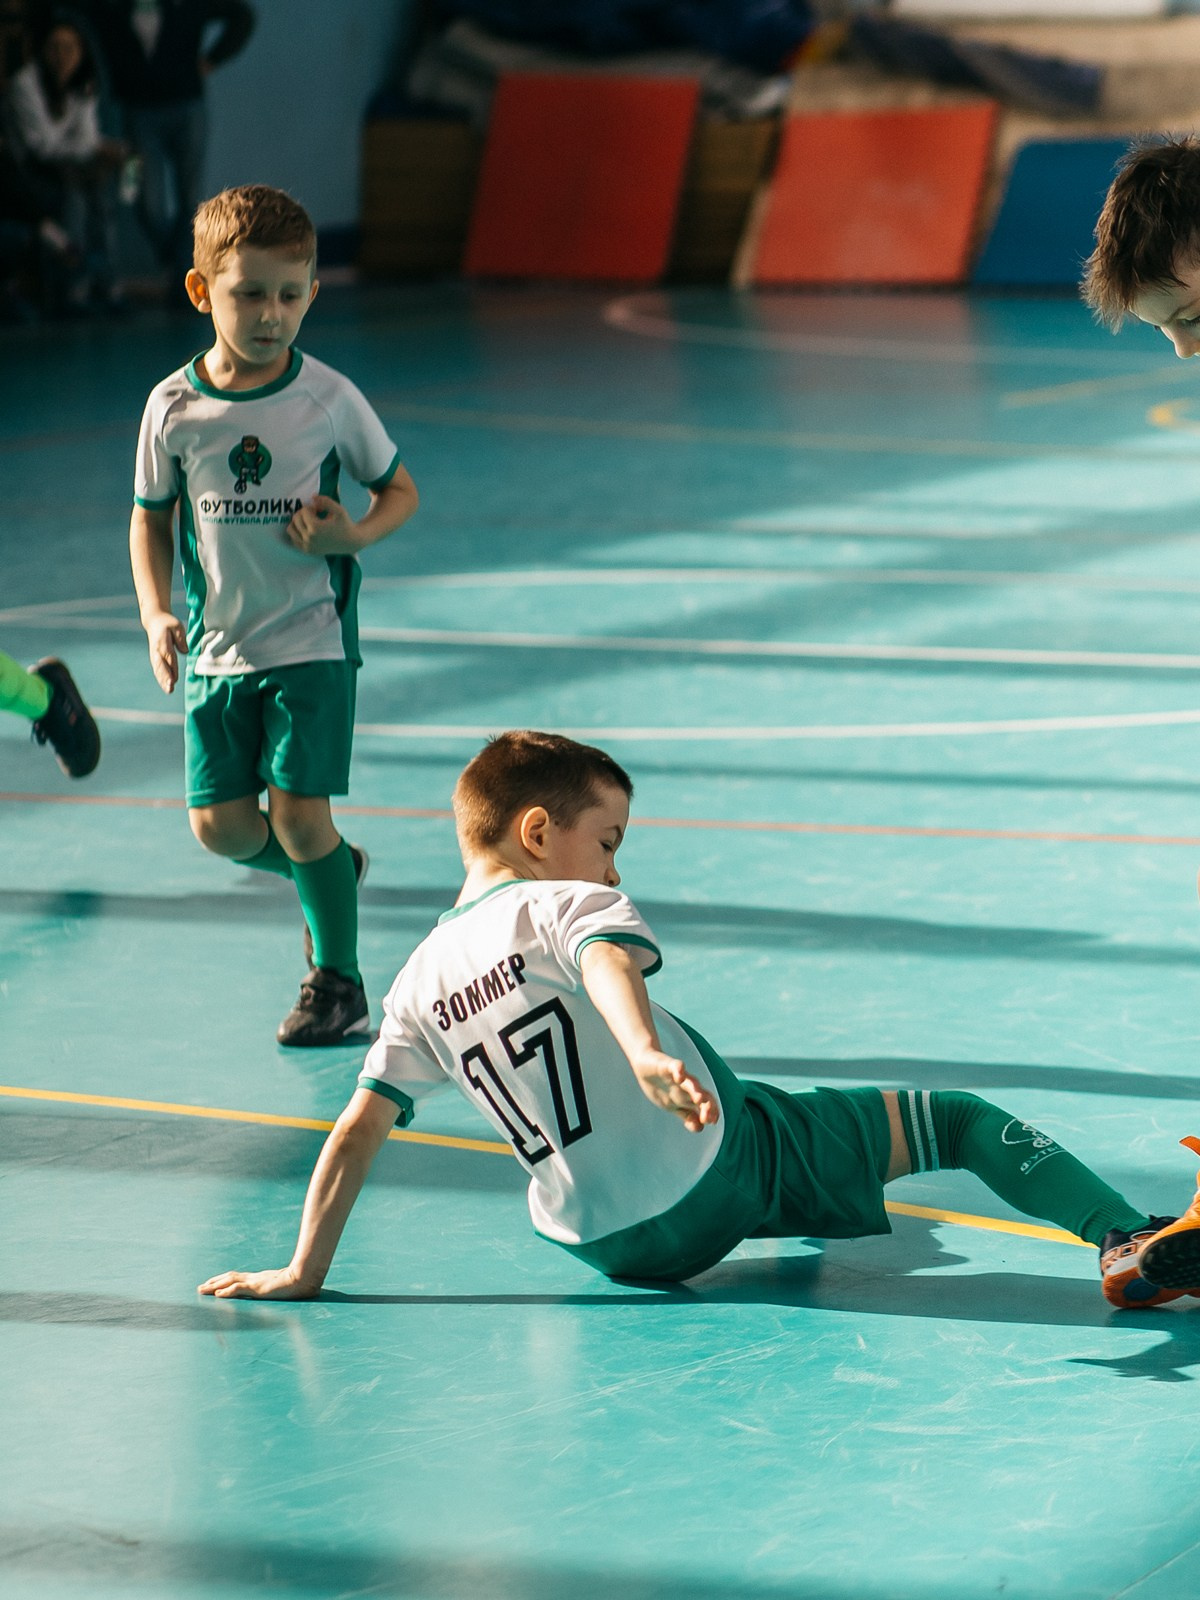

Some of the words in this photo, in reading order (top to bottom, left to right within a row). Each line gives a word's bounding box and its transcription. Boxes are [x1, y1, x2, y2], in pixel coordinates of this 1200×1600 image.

[200, 498, 303, 515] ФУТБОЛИКА
[432, 953, 526, 1032] ЗОММЕР
[461, 996, 593, 1167] 17
